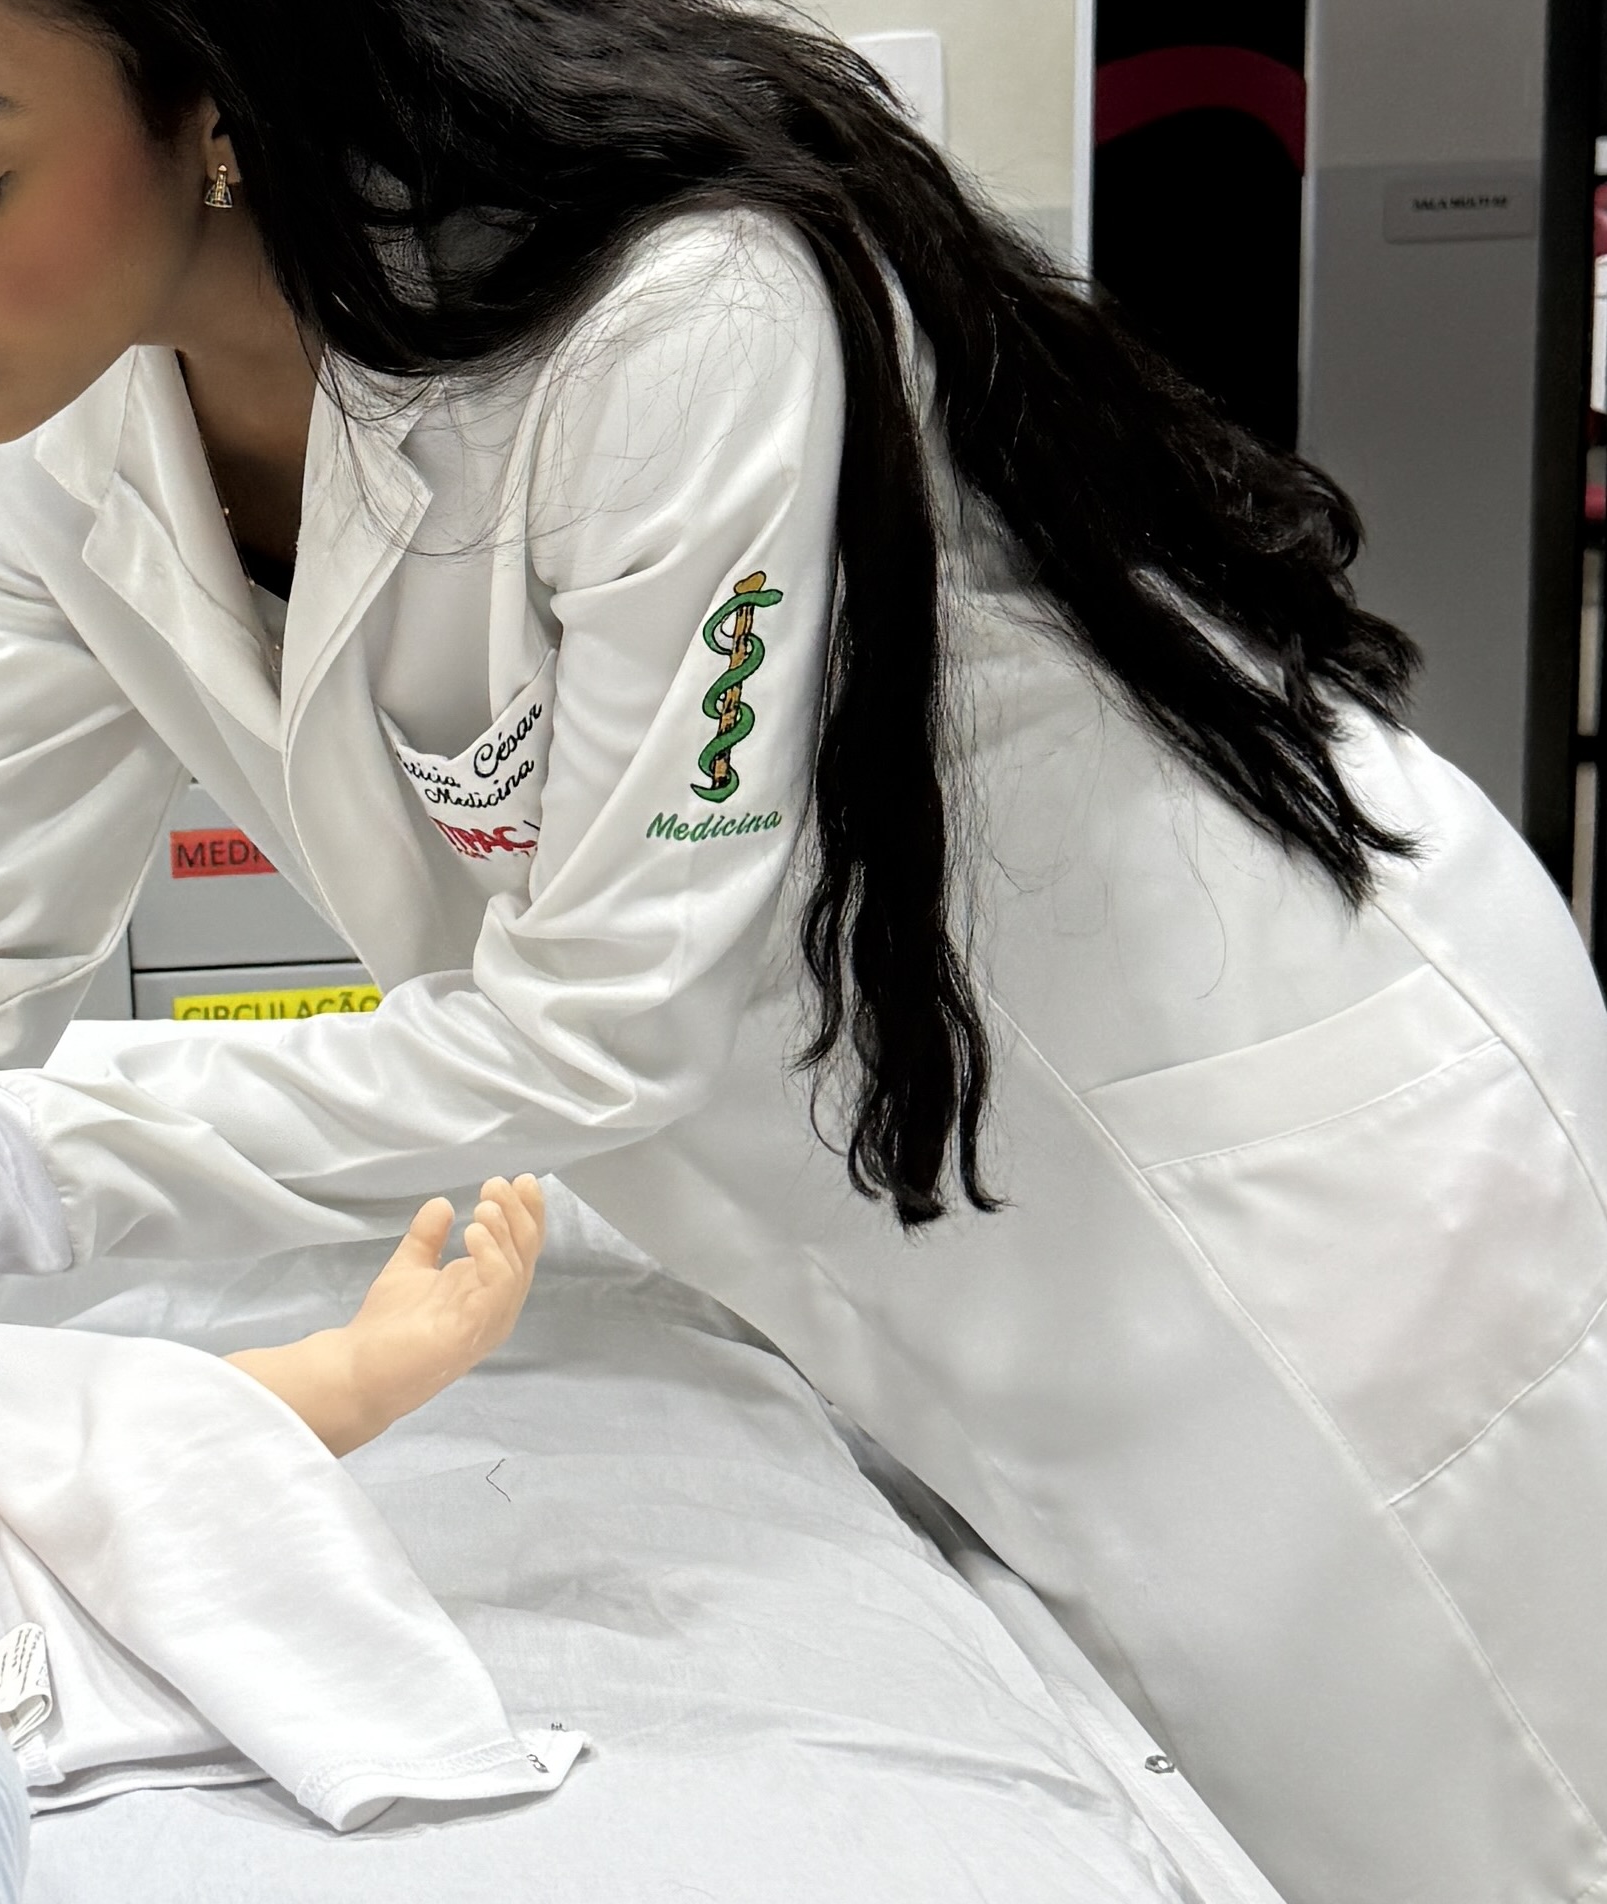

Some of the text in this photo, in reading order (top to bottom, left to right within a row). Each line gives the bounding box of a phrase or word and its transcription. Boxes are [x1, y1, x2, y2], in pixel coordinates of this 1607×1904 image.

[474, 702, 543, 778] César
[425, 760, 535, 808] Medicina
[646, 811, 782, 842] Medicina
